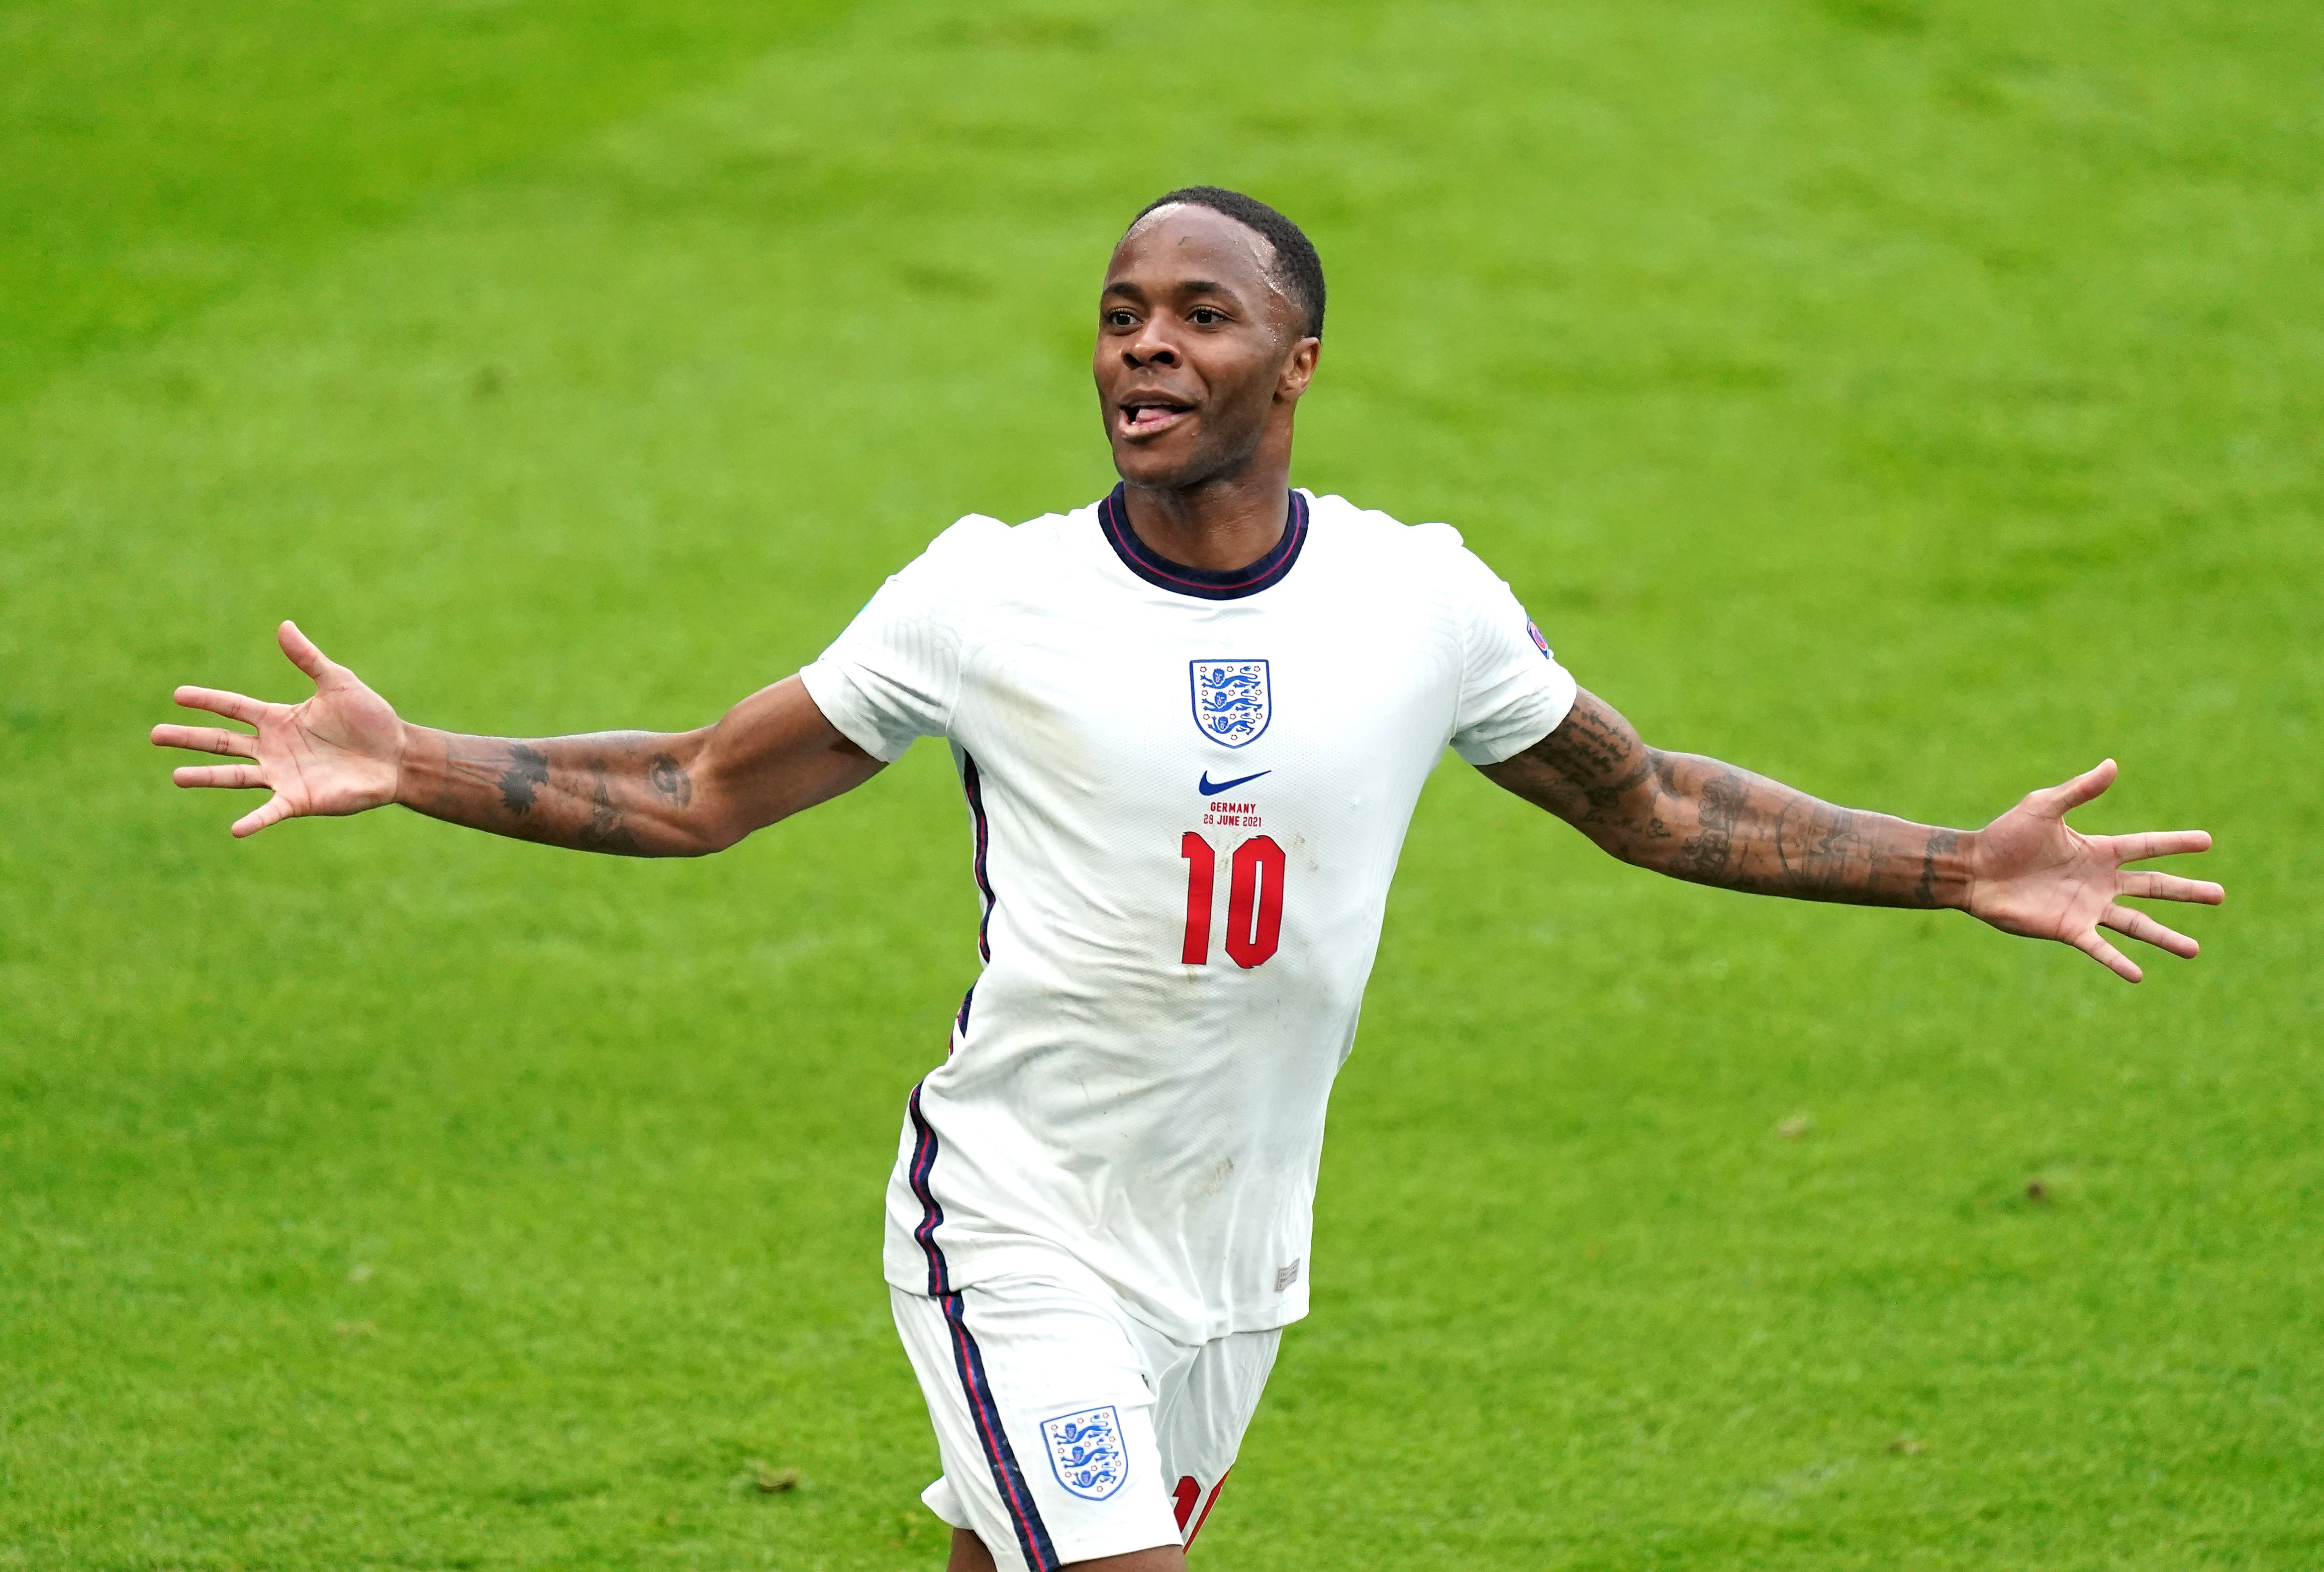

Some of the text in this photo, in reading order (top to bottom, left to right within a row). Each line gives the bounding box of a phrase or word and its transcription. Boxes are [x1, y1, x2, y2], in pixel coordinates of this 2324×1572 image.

[1203, 814, 1261, 827] 29 JUNE 2021
[1210, 802, 1256, 814] GERMANY
[1181, 831, 1285, 968] 10
[1172, 1465, 1233, 1555] 1
